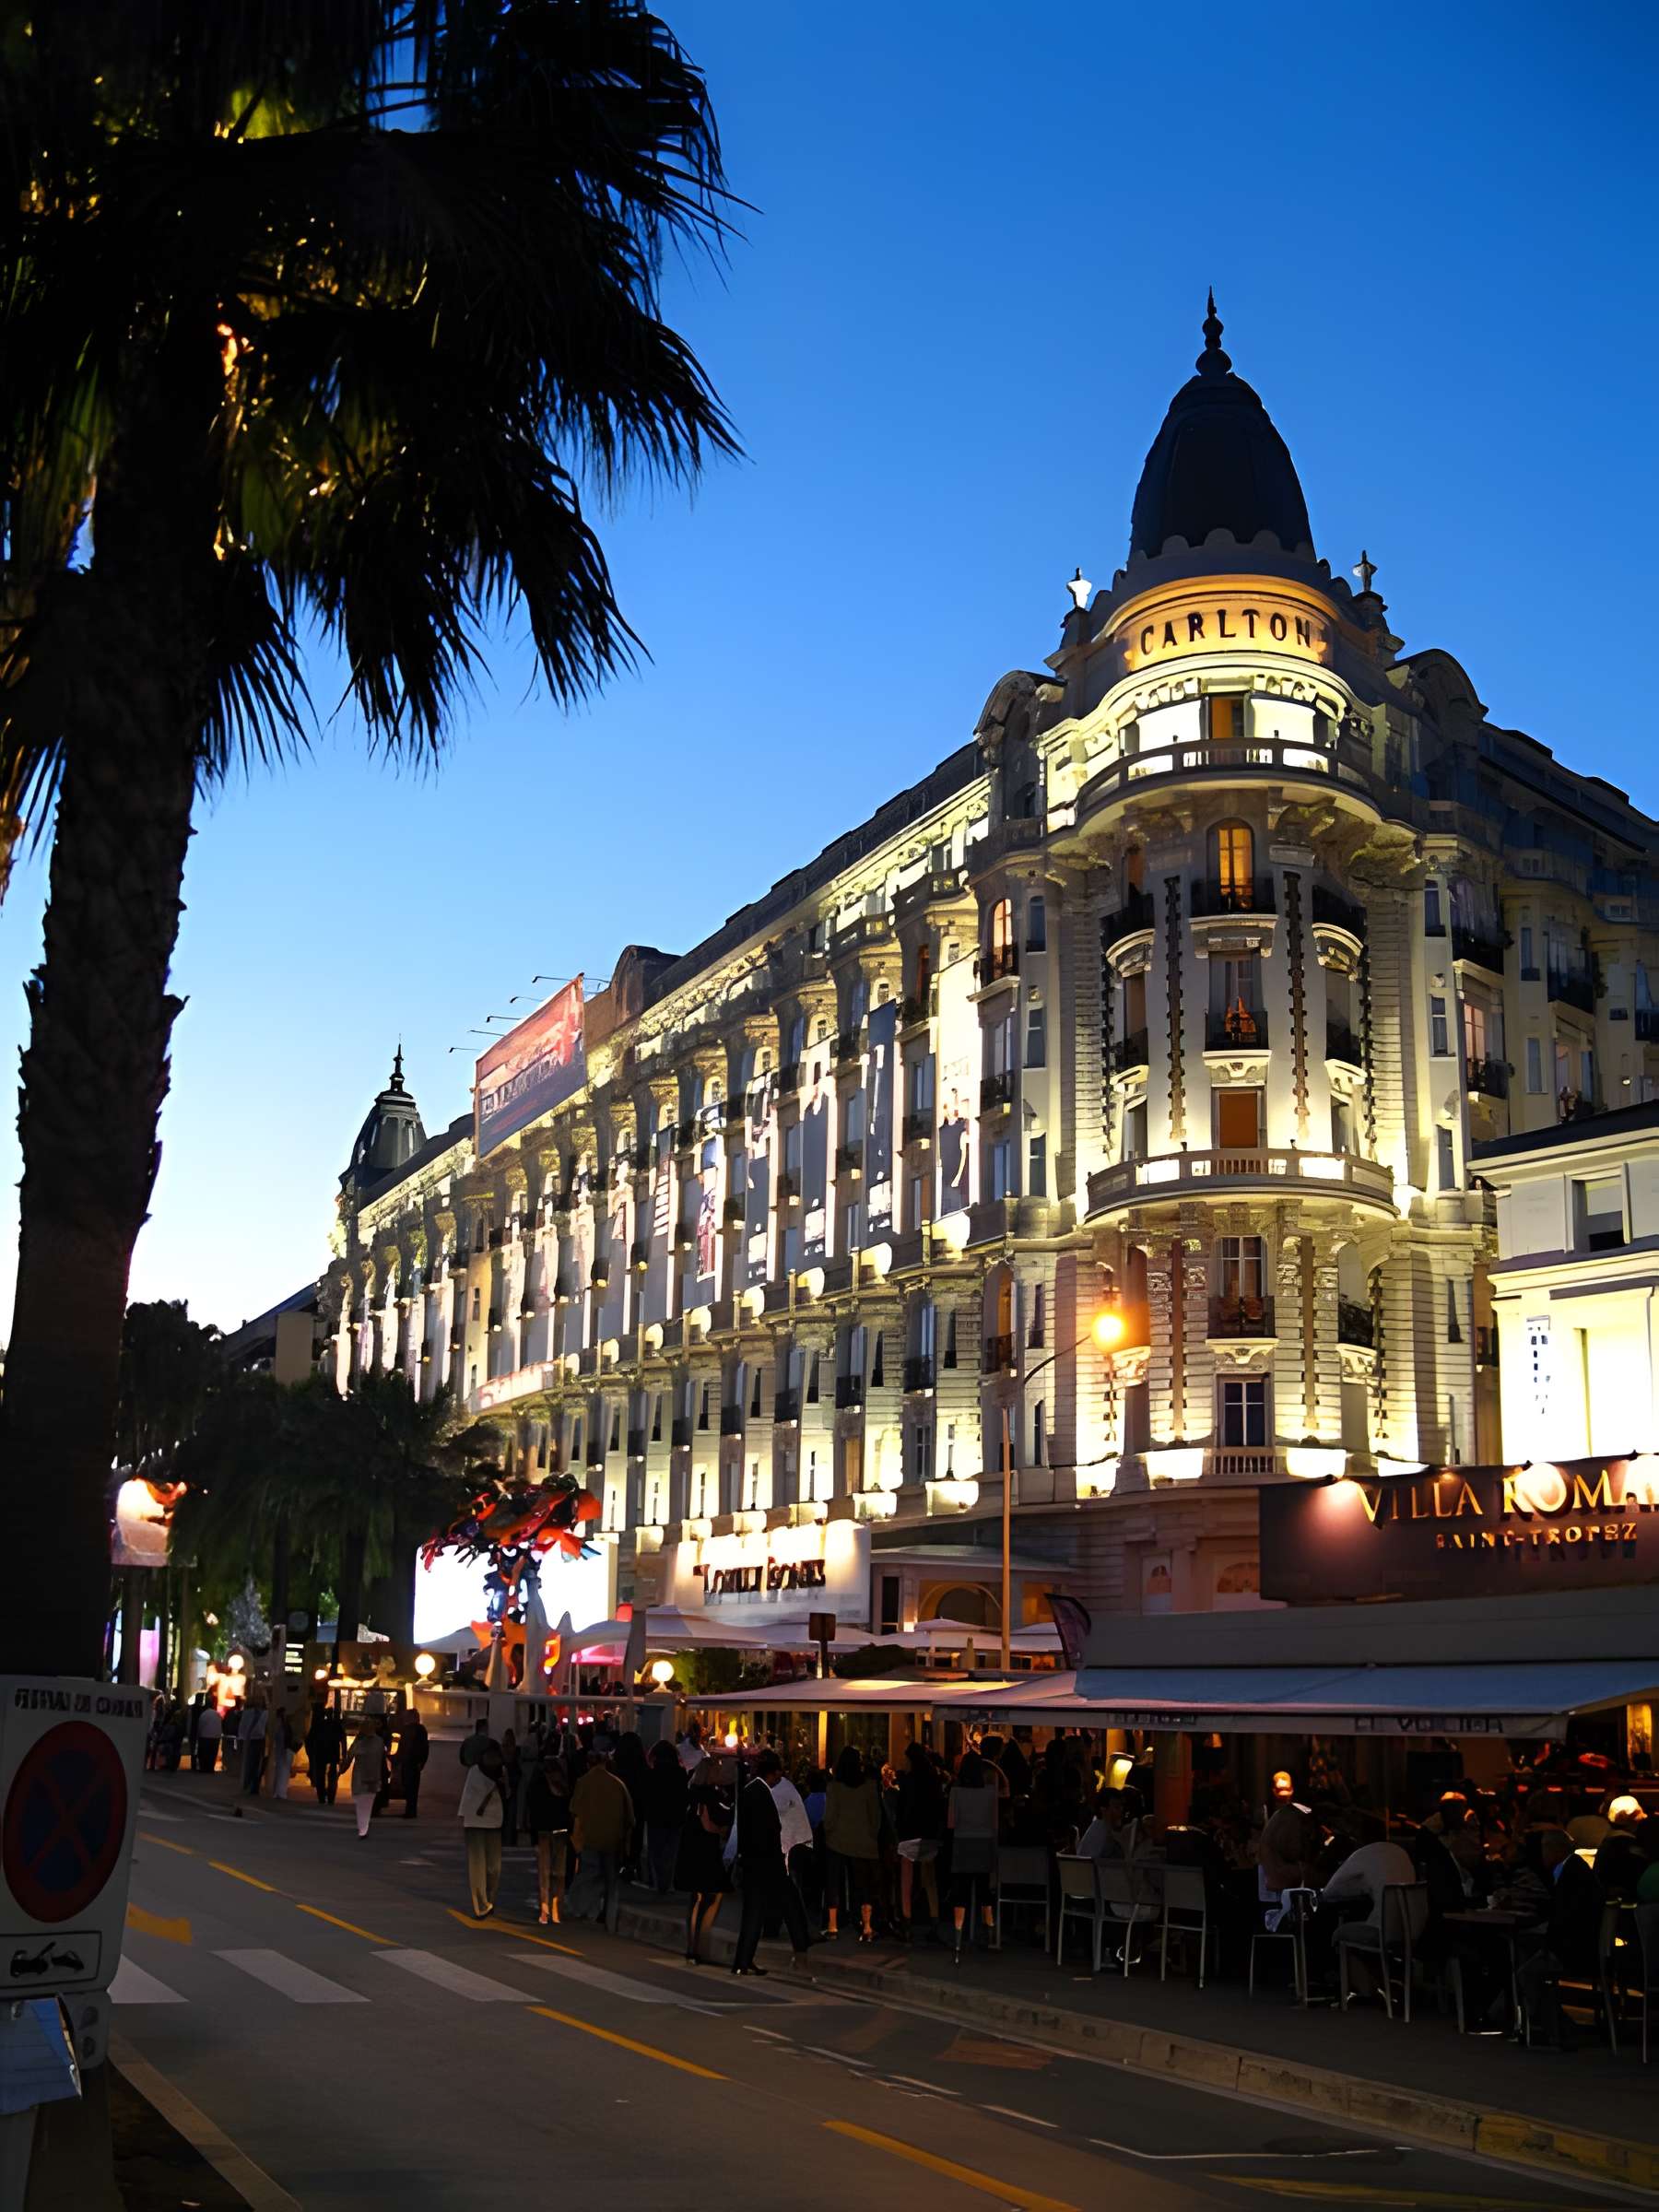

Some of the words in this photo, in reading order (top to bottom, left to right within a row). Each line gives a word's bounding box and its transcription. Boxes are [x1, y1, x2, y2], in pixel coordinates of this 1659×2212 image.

[1140, 608, 1312, 656] CARLTON
[1354, 1480, 1483, 1523] VILLA
[1502, 1463, 1659, 1513] ROMA
